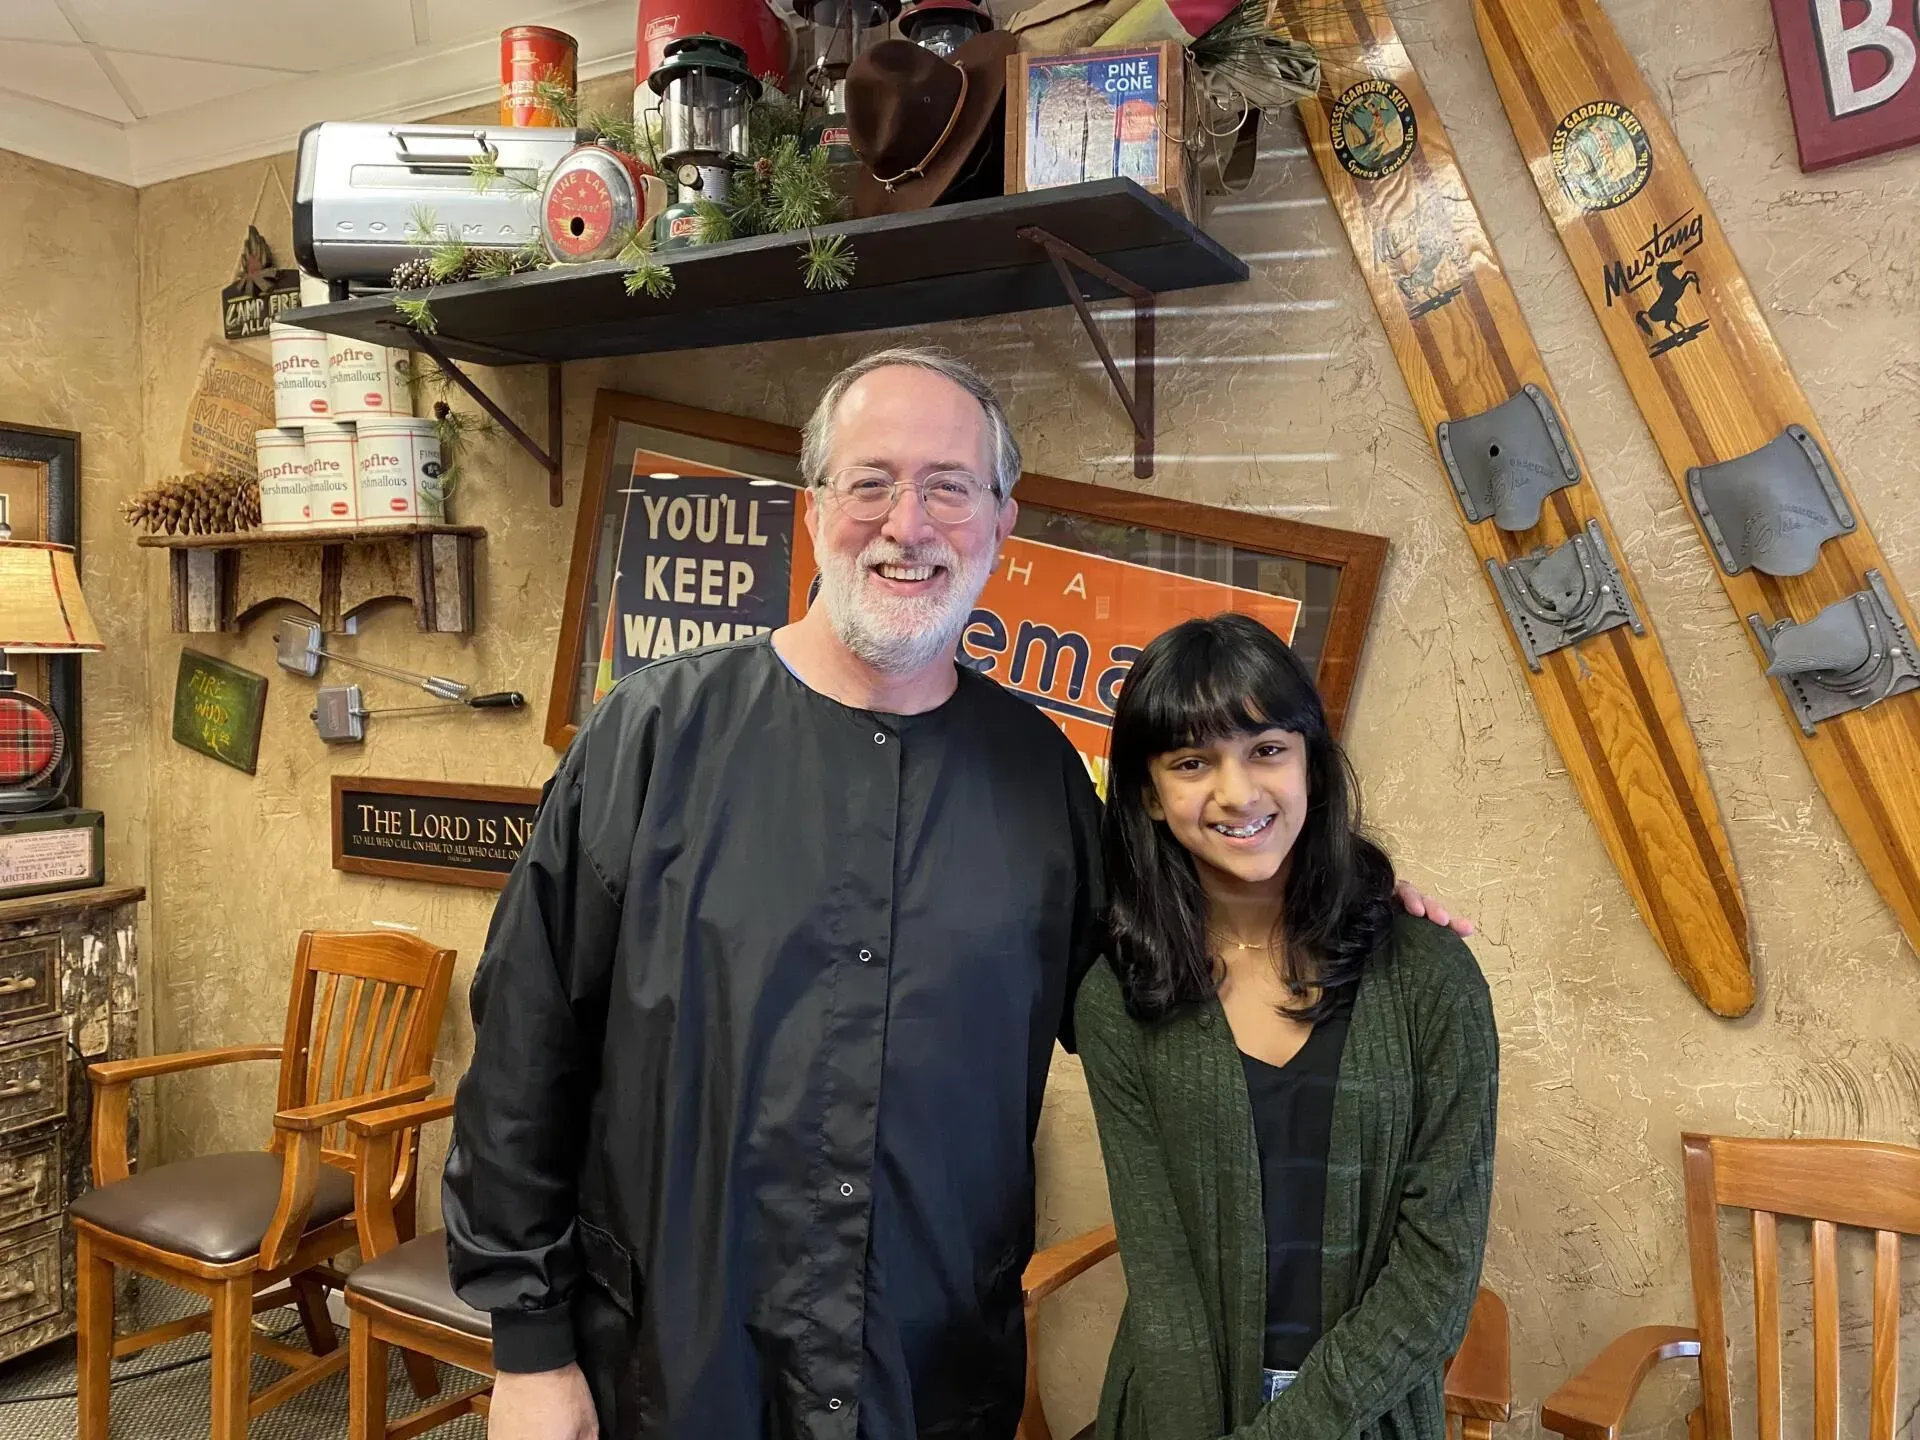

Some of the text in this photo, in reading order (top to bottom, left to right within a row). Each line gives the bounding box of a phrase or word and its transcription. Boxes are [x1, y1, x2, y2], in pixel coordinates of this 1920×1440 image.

[1105, 75, 1153, 92] CONE
[1108, 61, 1149, 77] PINE
[1331, 81, 1409, 149] CYPRESS GARDENS SKIS
[1564, 103, 1620, 129] GARDENS
[1618, 111, 1641, 136] SKIS
[1348, 160, 1378, 178] Cypress
[551, 173, 611, 209] PINE LAKE
[1603, 207, 1704, 307] Mustang
[226, 291, 301, 330] CAMP FIRE
[643, 493, 768, 547] YOU'LL
[644, 555, 755, 607] KEEP
[1063, 572, 1087, 600] A
[623, 613, 772, 660] WAR
[188, 669, 226, 700] FIRE
[195, 699, 229, 724] WOOD
[358, 804, 402, 836] THE
[409, 808, 470, 842] LORD
[476, 818, 498, 844] IS
[352, 834, 363, 845] TO
[363, 836, 376, 846] ALL
[375, 837, 393, 848] WHO
[394, 838, 412, 850] CALL
[412, 840, 425, 851] ON
[442, 843, 453, 854] TO
[454, 844, 467, 855] ALL
[467, 845, 487, 858] WHO
[488, 848, 508, 860] CALL
